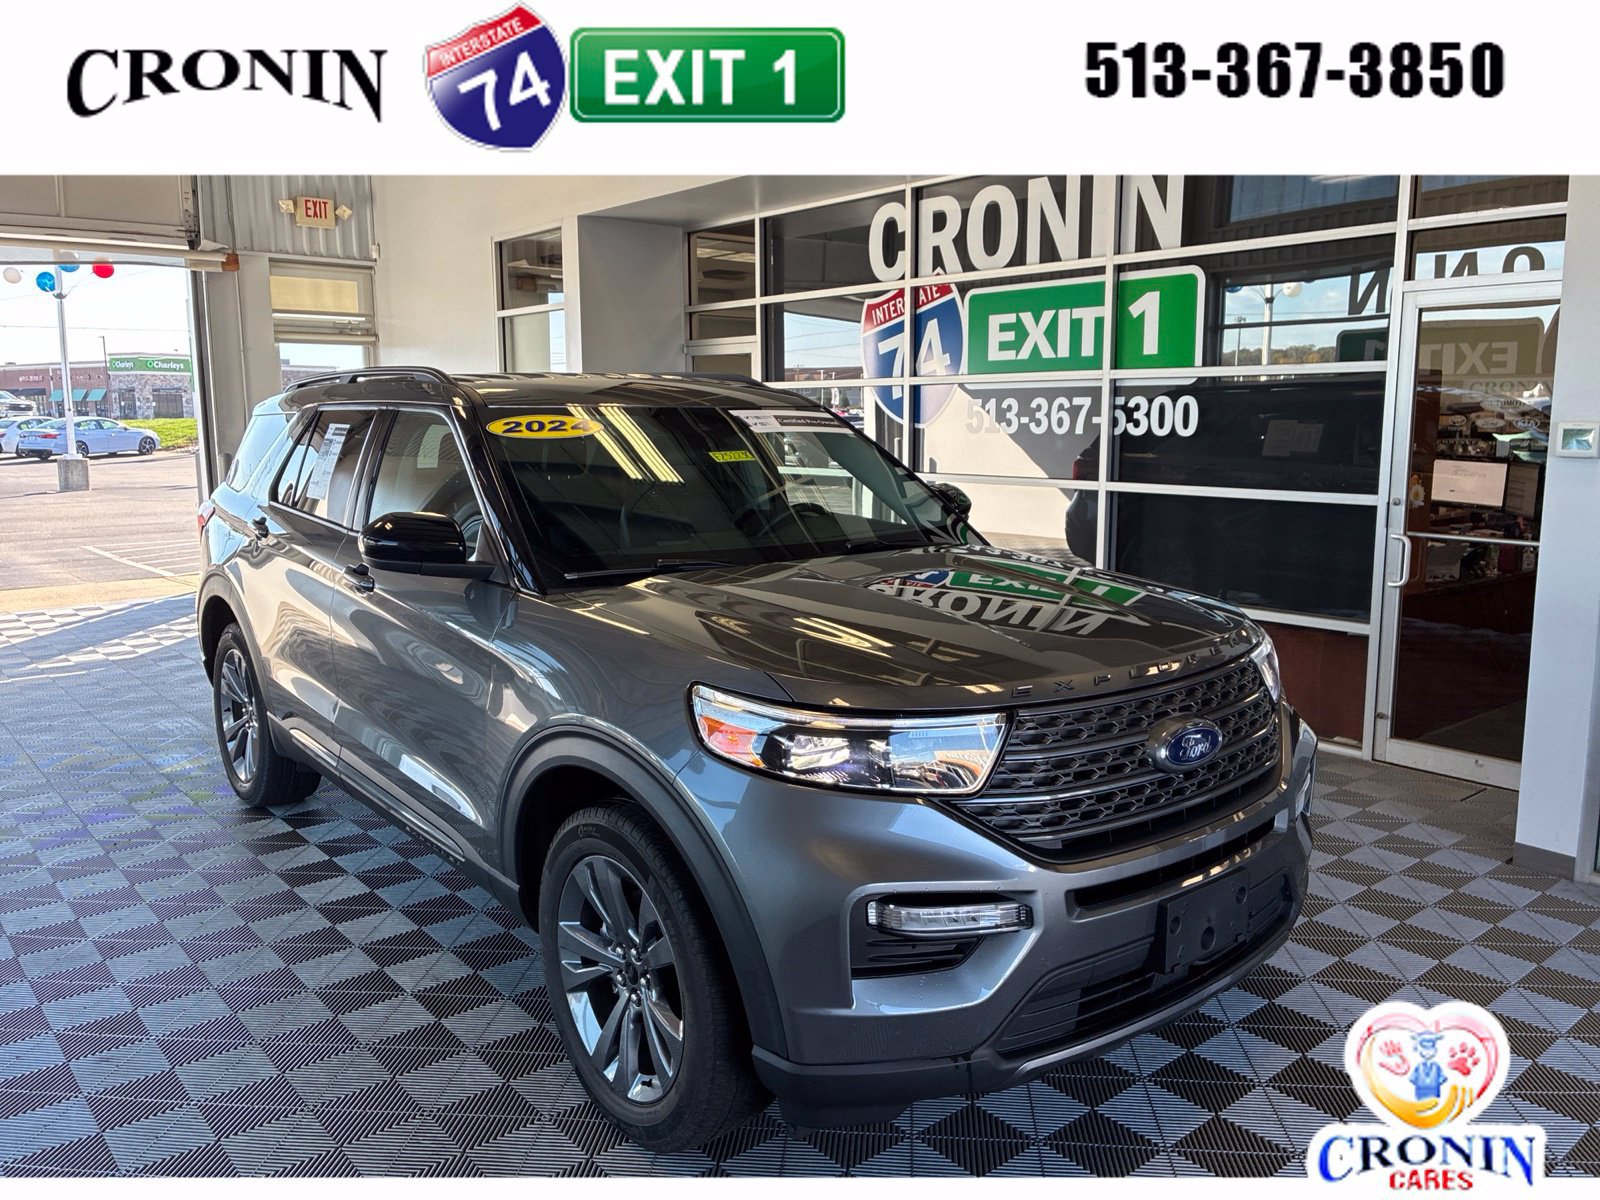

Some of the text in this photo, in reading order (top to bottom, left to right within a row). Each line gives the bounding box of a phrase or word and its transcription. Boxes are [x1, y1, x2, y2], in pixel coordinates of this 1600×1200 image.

[304, 199, 328, 219] EXIT
[868, 175, 1184, 281] CRONIN
[872, 285, 941, 325] INTERATE
[987, 290, 1160, 361] EXIT 1
[153, 361, 184, 370] Charleys
[877, 318, 951, 400] 74
[502, 420, 591, 434] 2024
[965, 395, 1199, 437] 513-367-5300
[1179, 734, 1212, 760] Ford
